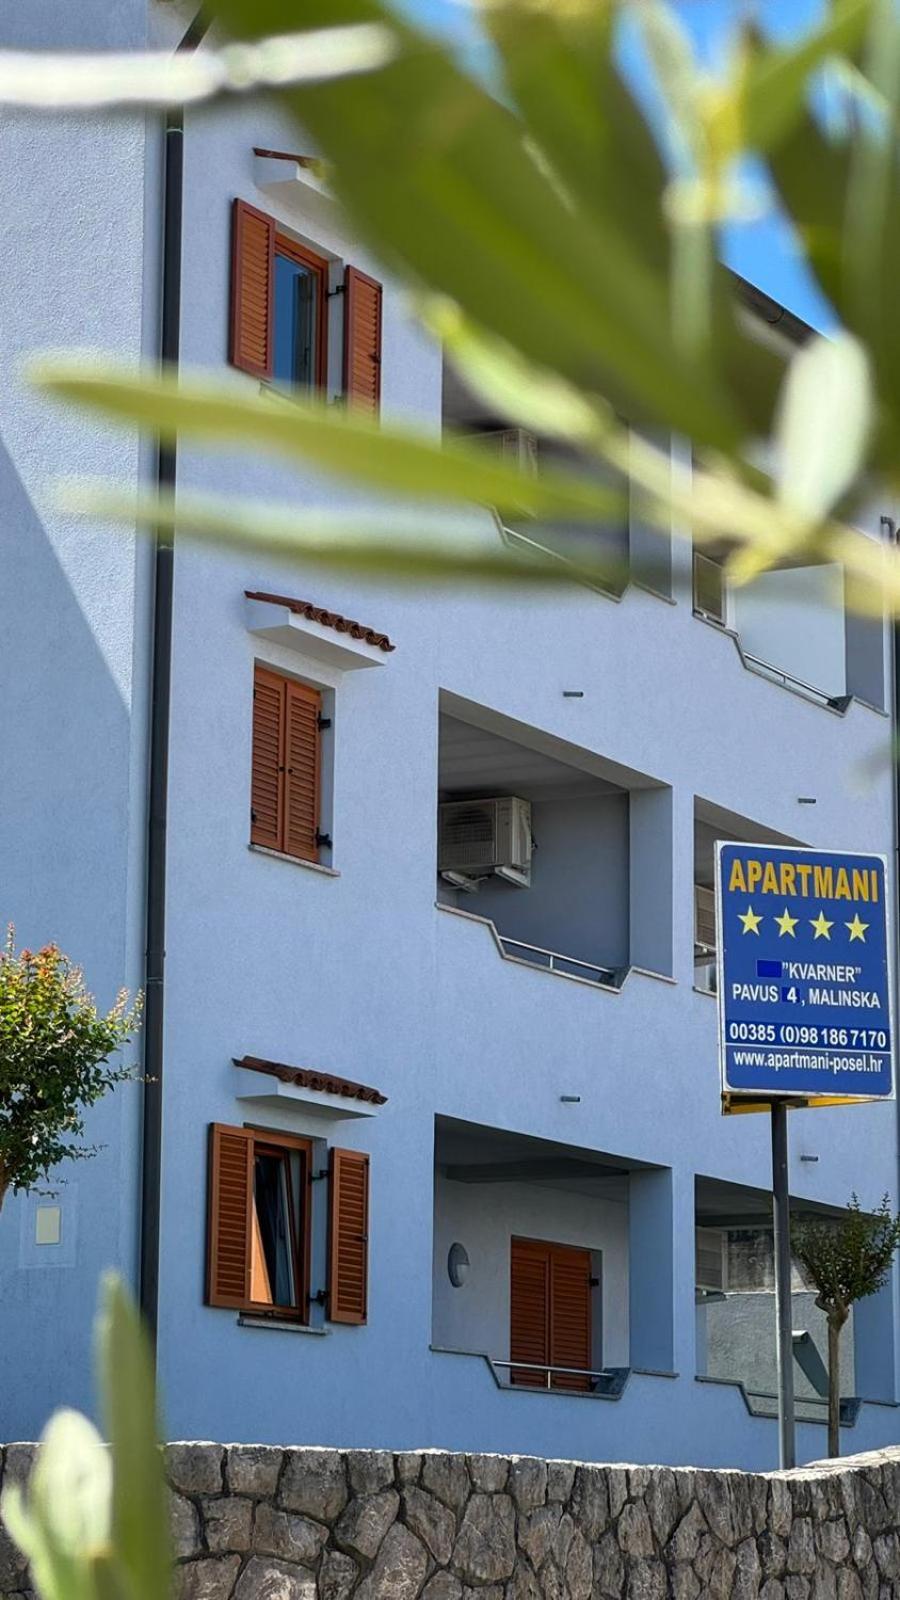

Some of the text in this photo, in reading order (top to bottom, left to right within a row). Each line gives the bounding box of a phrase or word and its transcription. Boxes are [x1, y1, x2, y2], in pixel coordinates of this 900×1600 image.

[729, 859, 878, 902] APARTMANI
[732, 983, 779, 1003] PAVUS
[808, 989, 881, 1009] MALINSKA
[729, 1023, 776, 1041] 00385
[851, 1031, 887, 1048] 7170
[734, 1051, 883, 1074] www.apartmani-posel.hr
